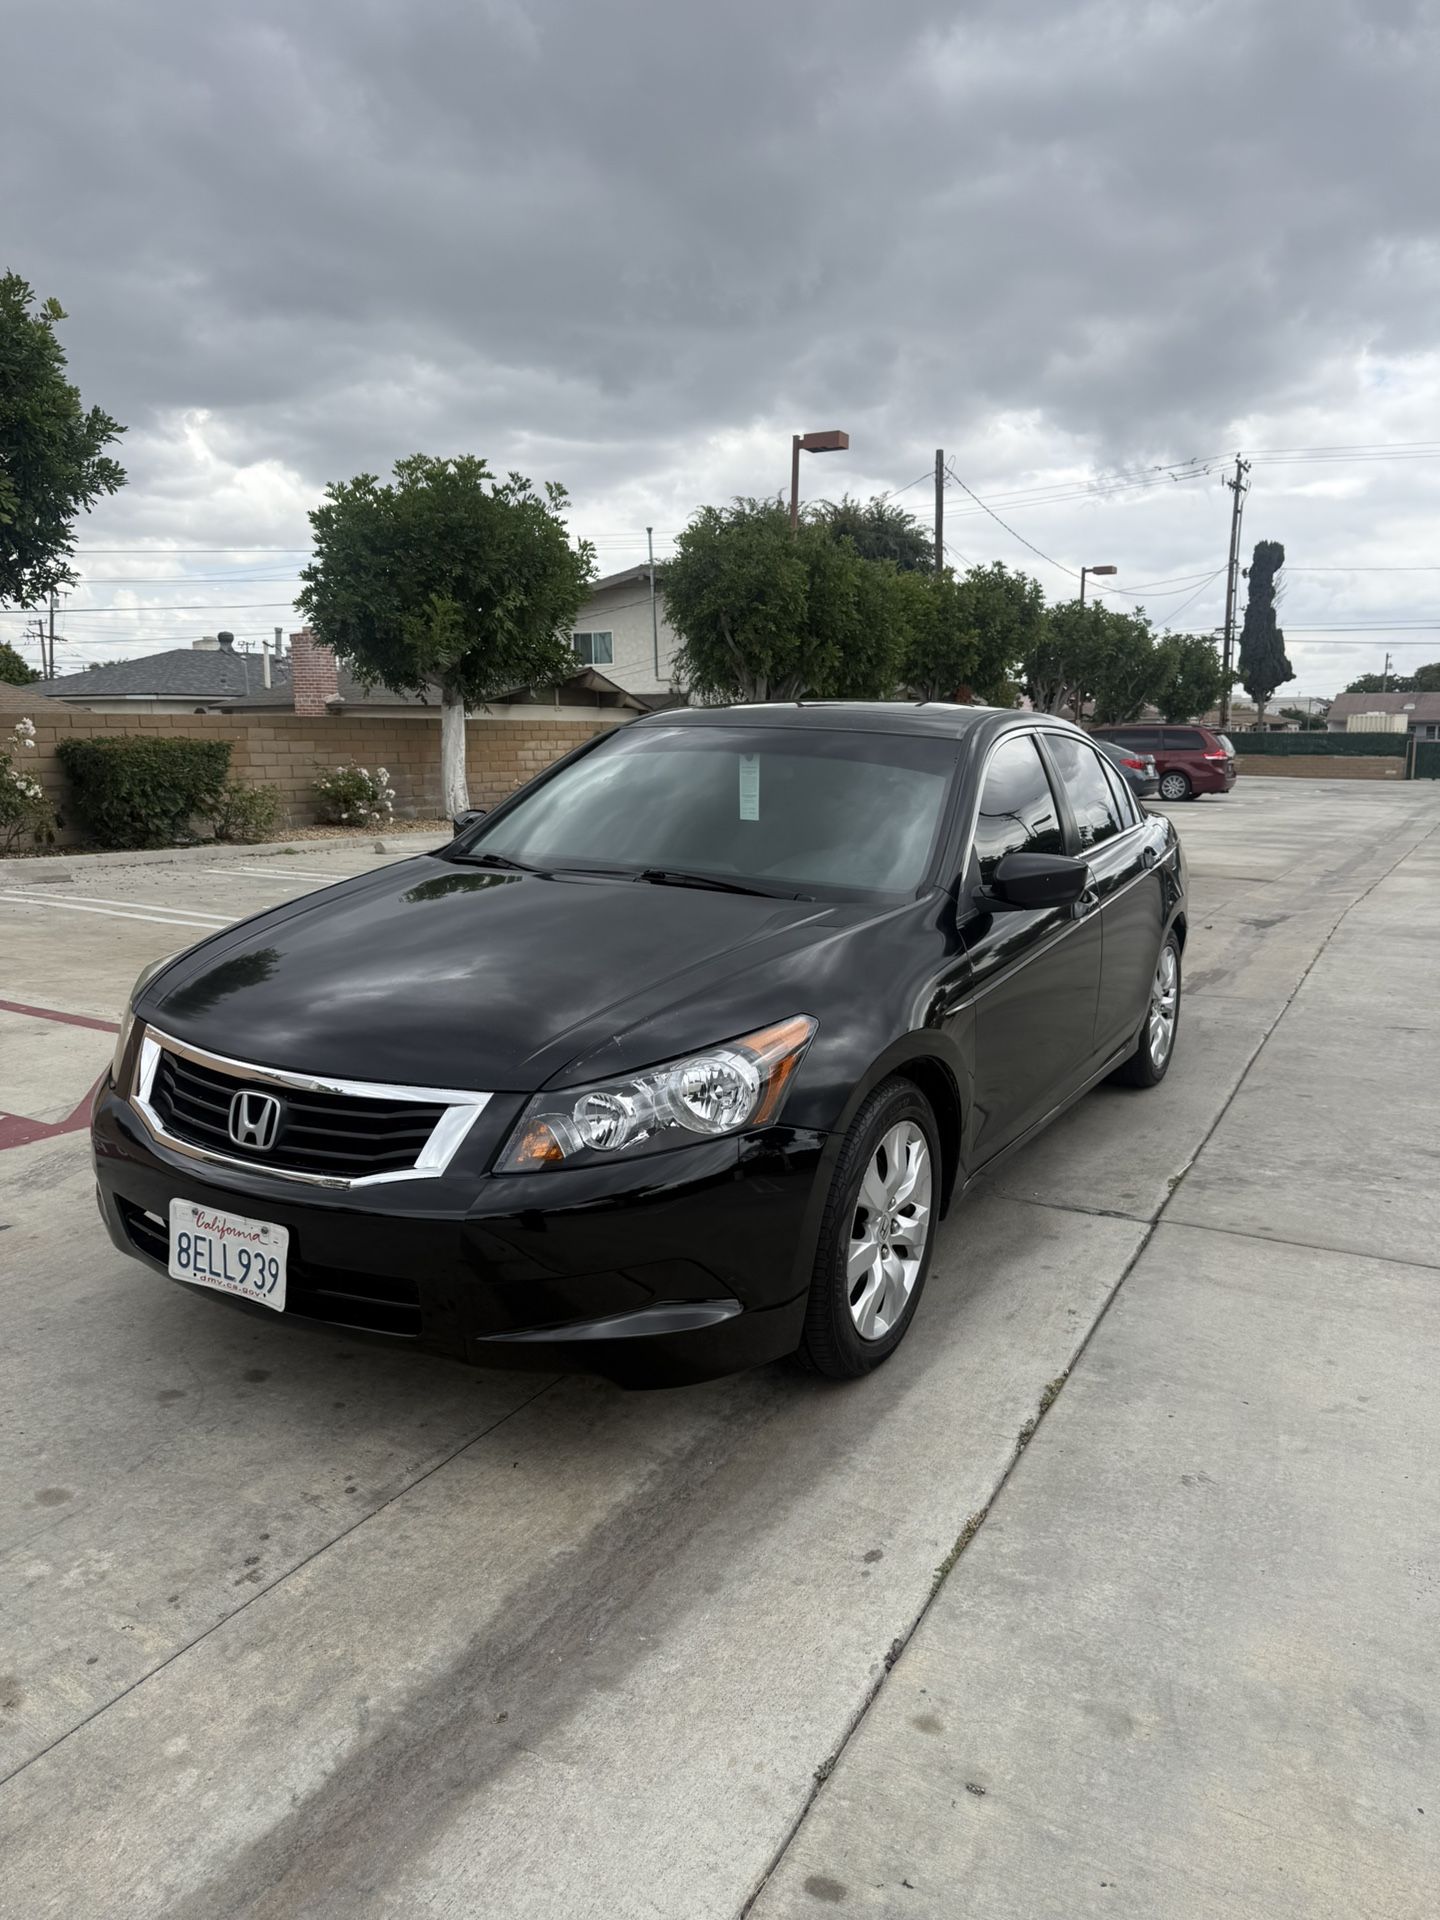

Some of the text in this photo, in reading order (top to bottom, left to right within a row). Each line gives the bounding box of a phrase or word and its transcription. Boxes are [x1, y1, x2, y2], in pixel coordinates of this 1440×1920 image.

[196, 1211, 268, 1245] California
[177, 1232, 279, 1294] 8ELL939
[200, 1274, 261, 1297] dmv.ca.gov
